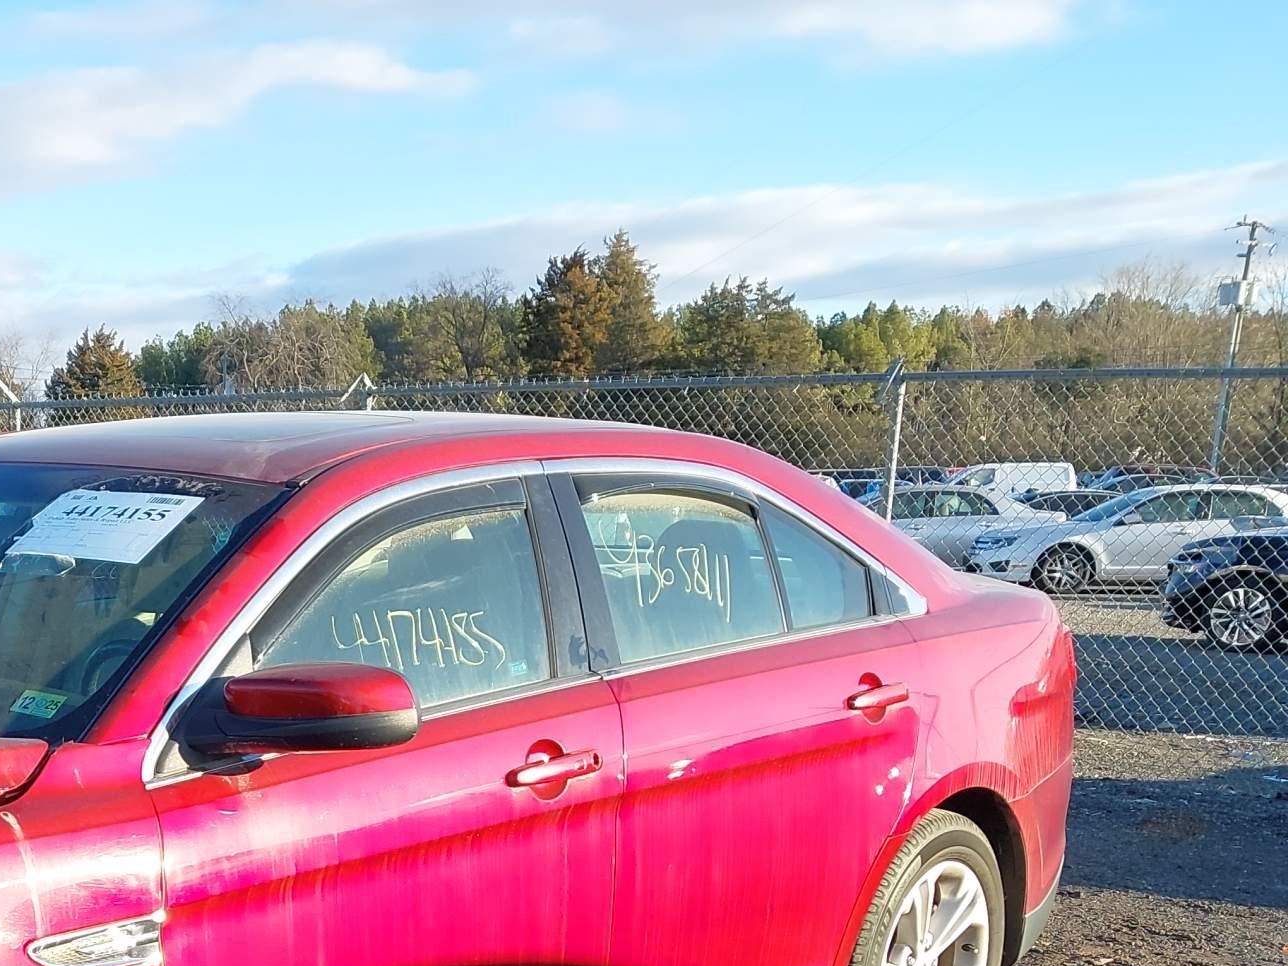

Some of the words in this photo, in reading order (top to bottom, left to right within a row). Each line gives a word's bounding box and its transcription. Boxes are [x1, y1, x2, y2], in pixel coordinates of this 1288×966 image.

[62, 504, 173, 523] 44174155
[18, 695, 36, 709] 12
[45, 699, 61, 711] 25
